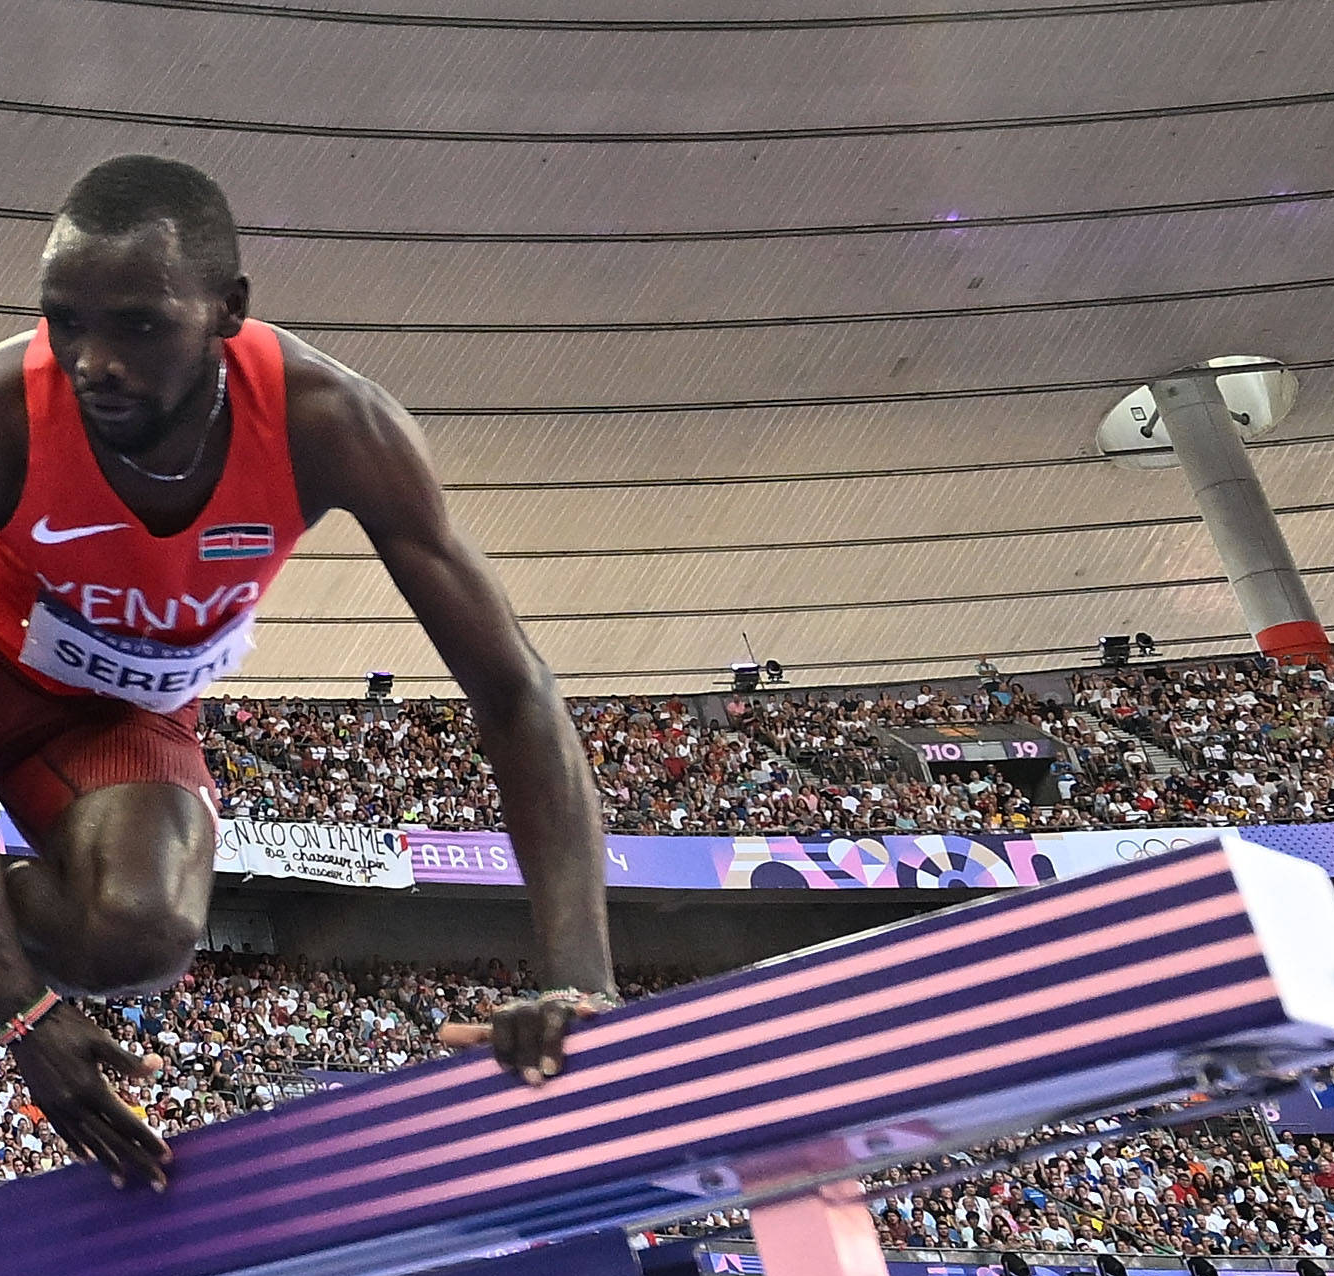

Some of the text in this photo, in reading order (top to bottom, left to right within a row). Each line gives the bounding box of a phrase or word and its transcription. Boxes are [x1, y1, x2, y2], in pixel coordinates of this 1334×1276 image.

[921, 743, 961, 761] J10
[1012, 741, 1038, 758] J9
[234, 821, 286, 847] NICO
[289, 824, 322, 849] ON
